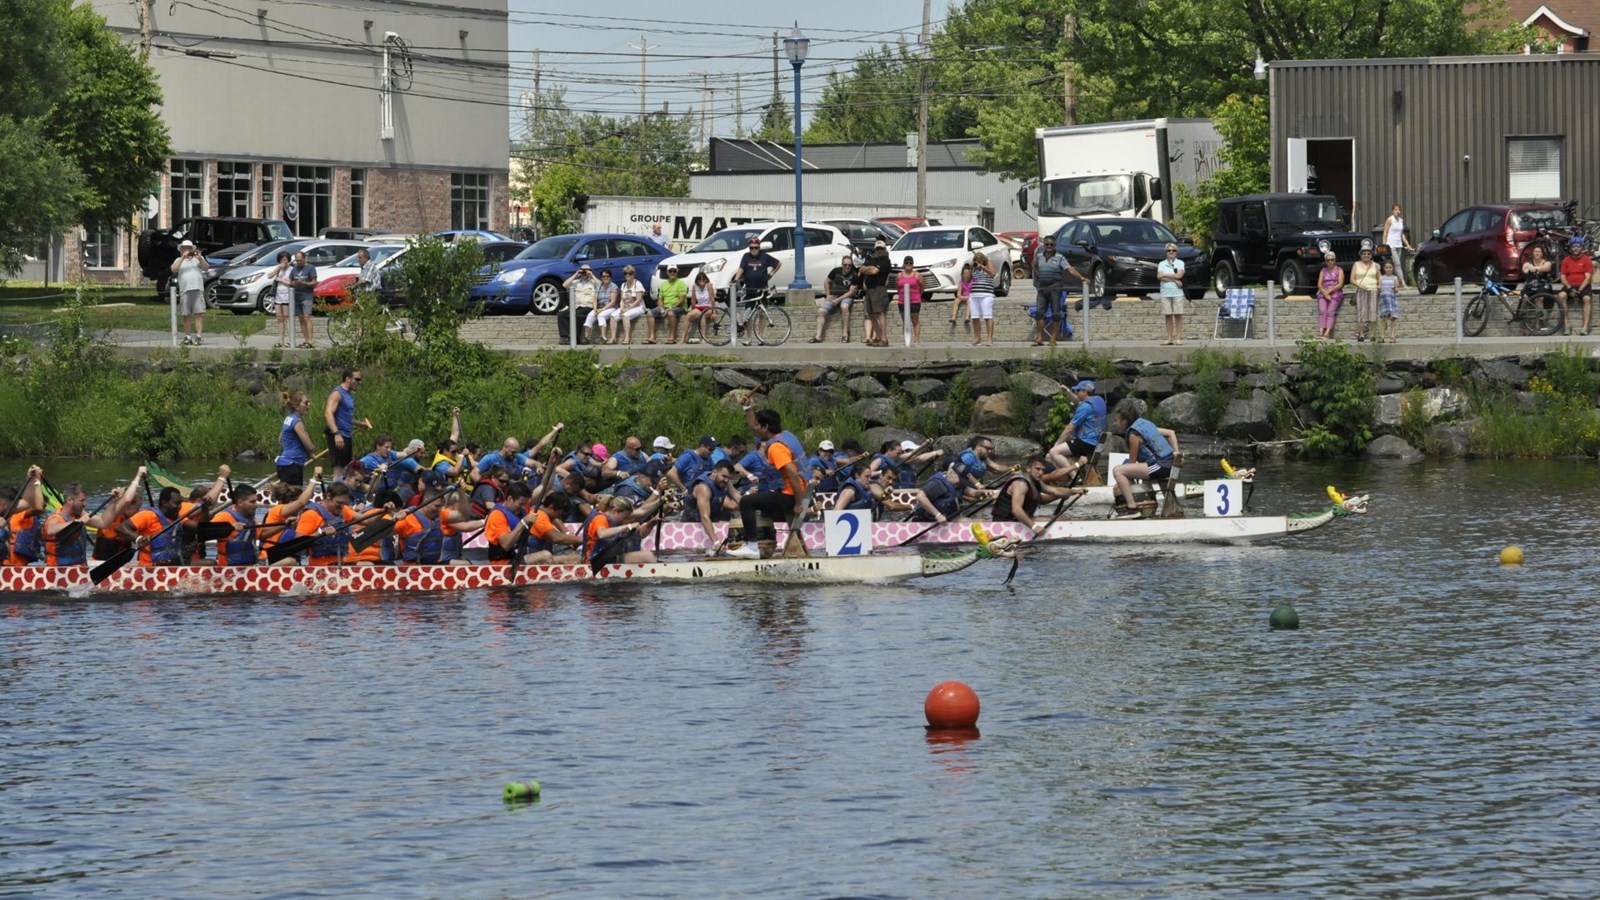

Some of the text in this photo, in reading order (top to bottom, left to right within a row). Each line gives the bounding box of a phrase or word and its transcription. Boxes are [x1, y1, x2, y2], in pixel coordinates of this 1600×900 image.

[630, 214, 672, 223] GROUPE
[1216, 483, 1230, 516] 3
[835, 512, 862, 556] 2
